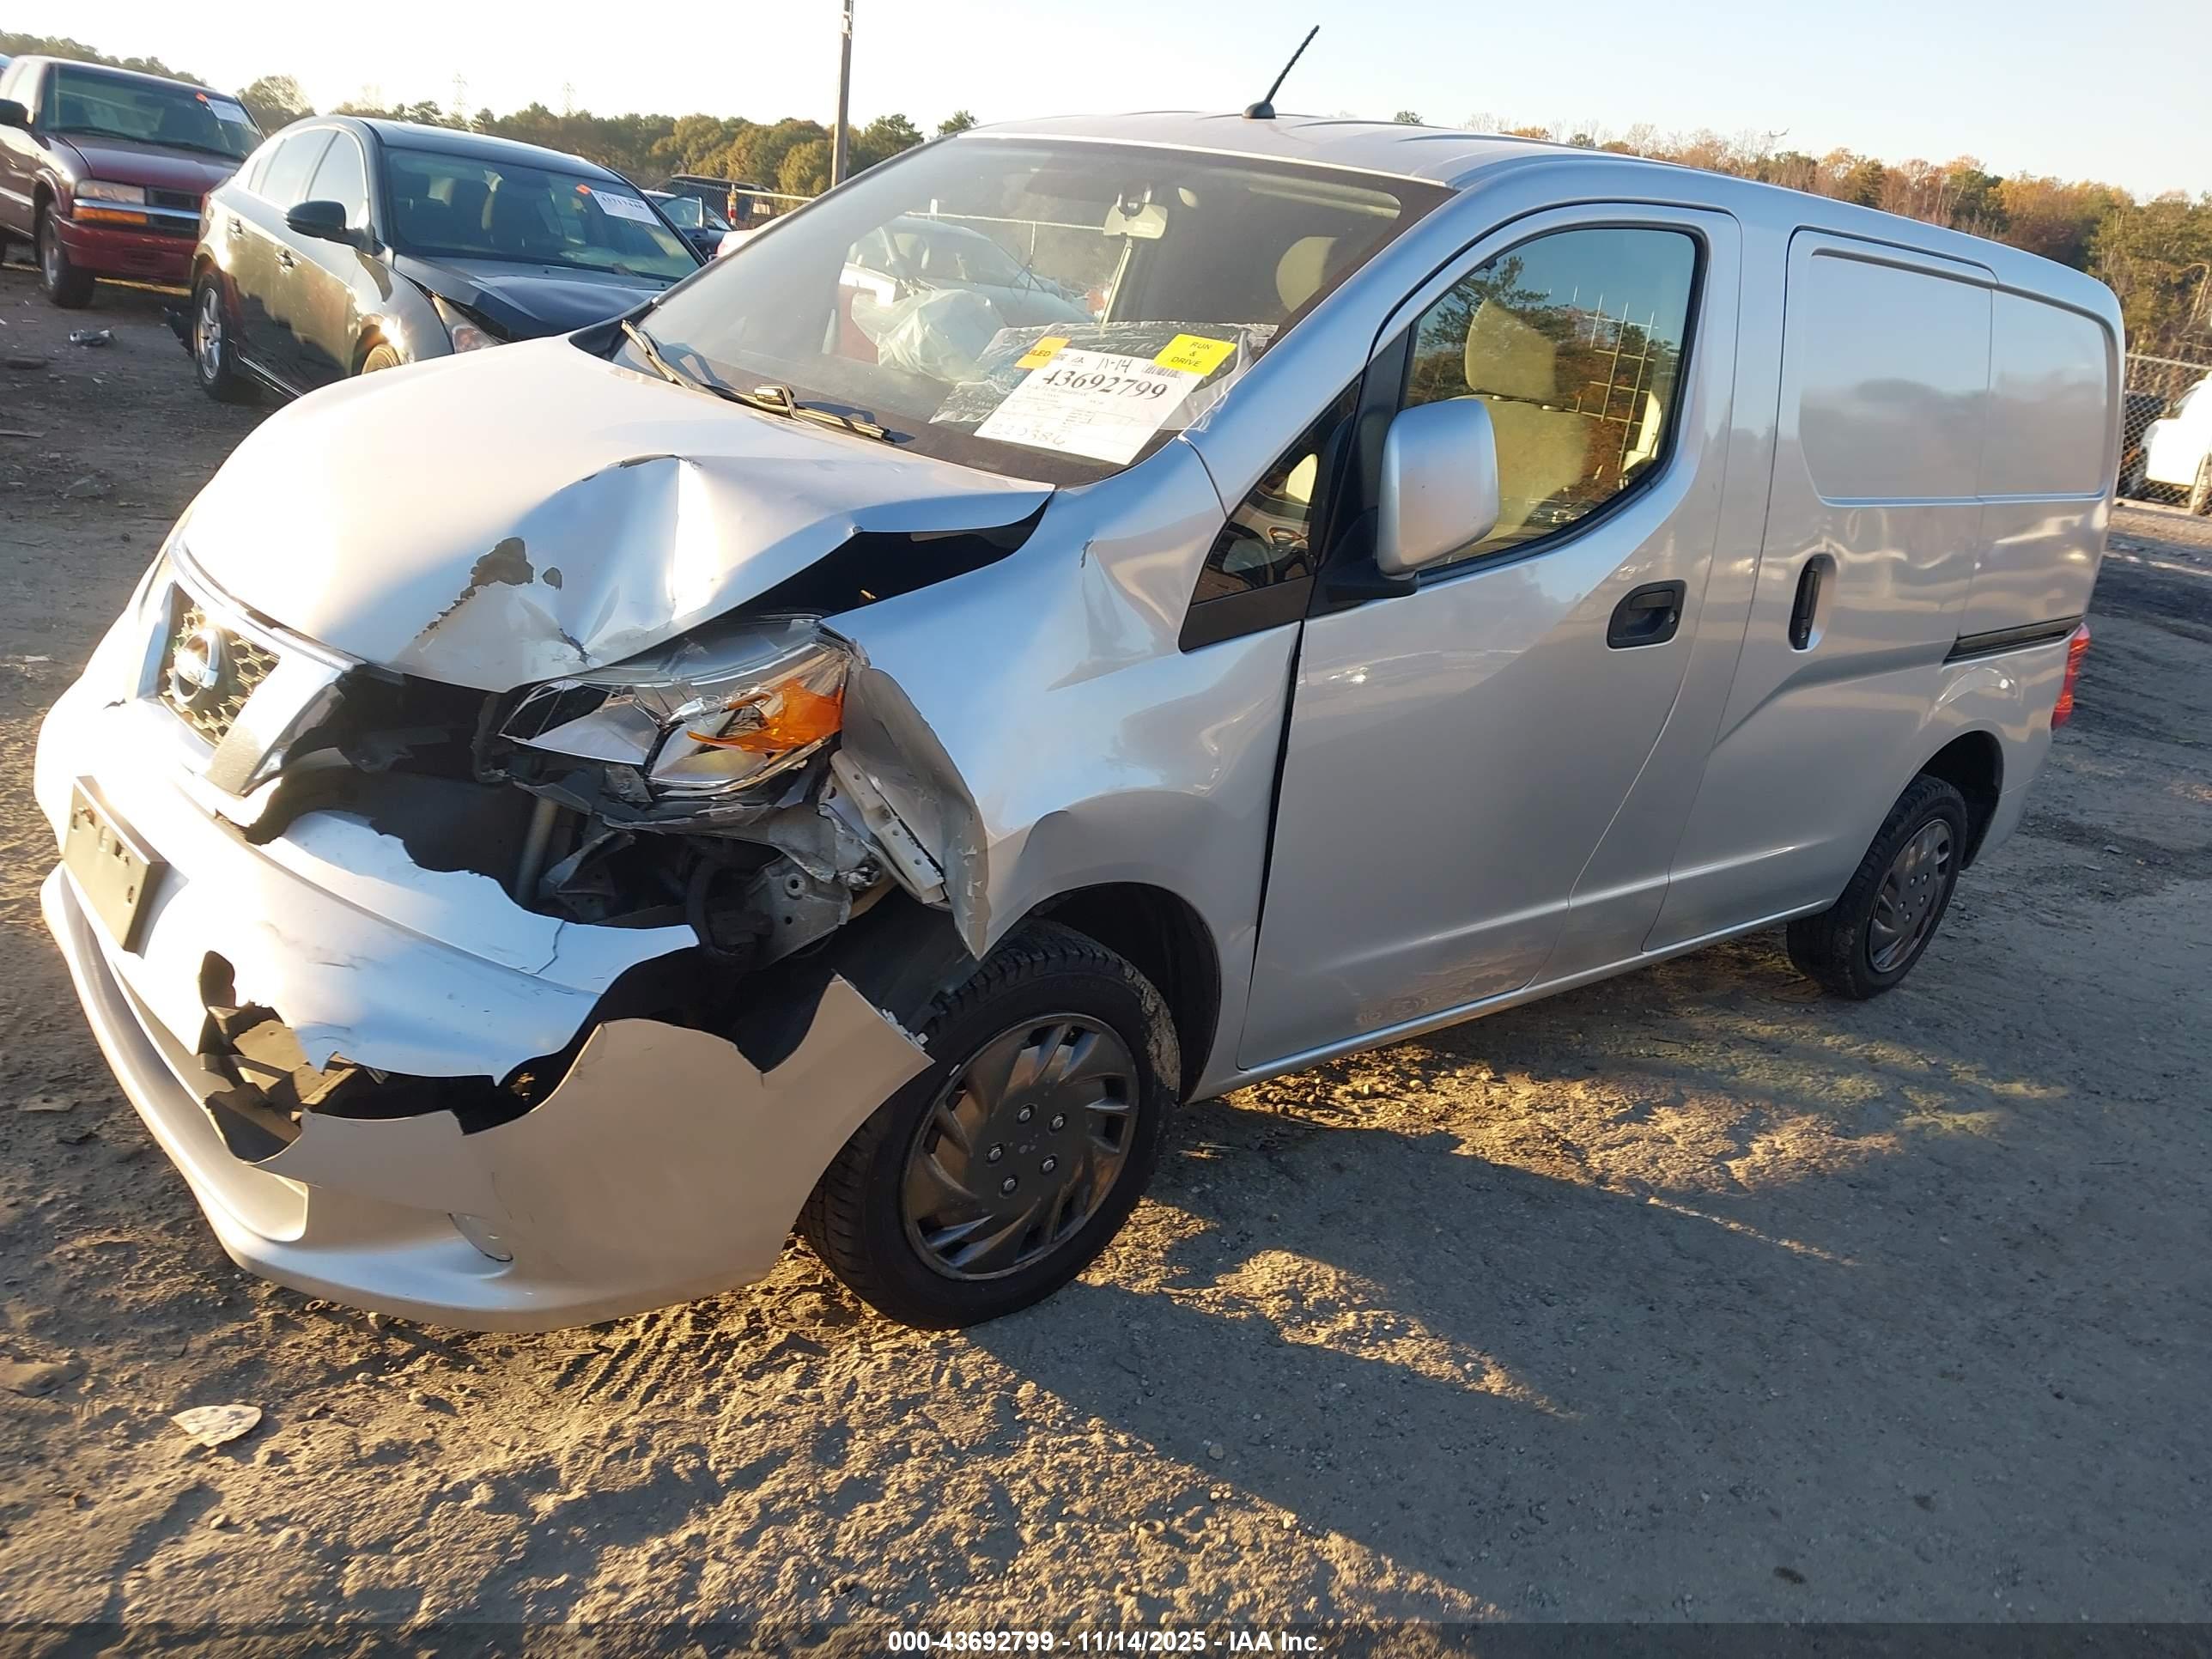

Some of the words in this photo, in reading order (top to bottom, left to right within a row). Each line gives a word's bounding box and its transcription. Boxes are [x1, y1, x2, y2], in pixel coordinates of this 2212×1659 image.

[1189, 341, 1212, 350] RUN
[1170, 356, 1202, 368] DRIVE
[1042, 369, 1169, 400] 43692799
